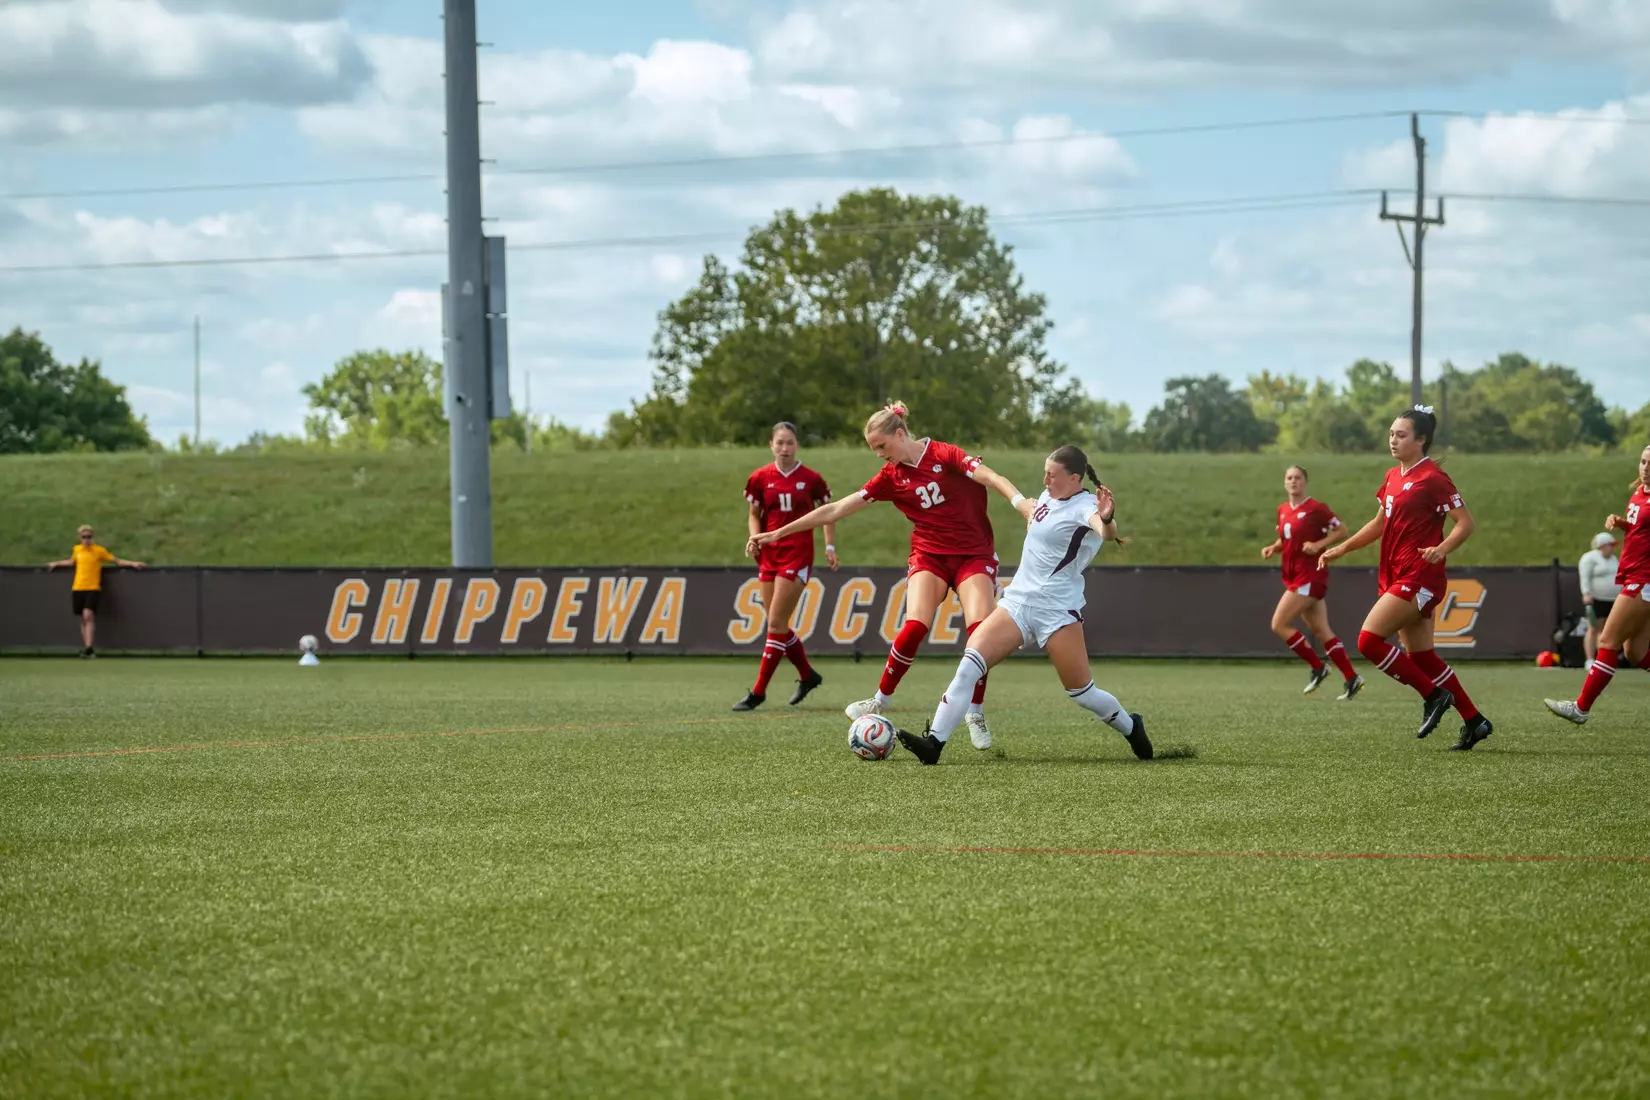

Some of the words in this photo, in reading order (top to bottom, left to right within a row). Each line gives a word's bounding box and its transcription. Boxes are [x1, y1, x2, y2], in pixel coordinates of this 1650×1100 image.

[778, 493, 792, 512] 11
[915, 481, 945, 509] 32
[1385, 495, 1394, 518] 5
[1626, 502, 1640, 525] 23
[325, 577, 686, 643] CHIPPEWA
[727, 577, 1013, 644] SOCCE
